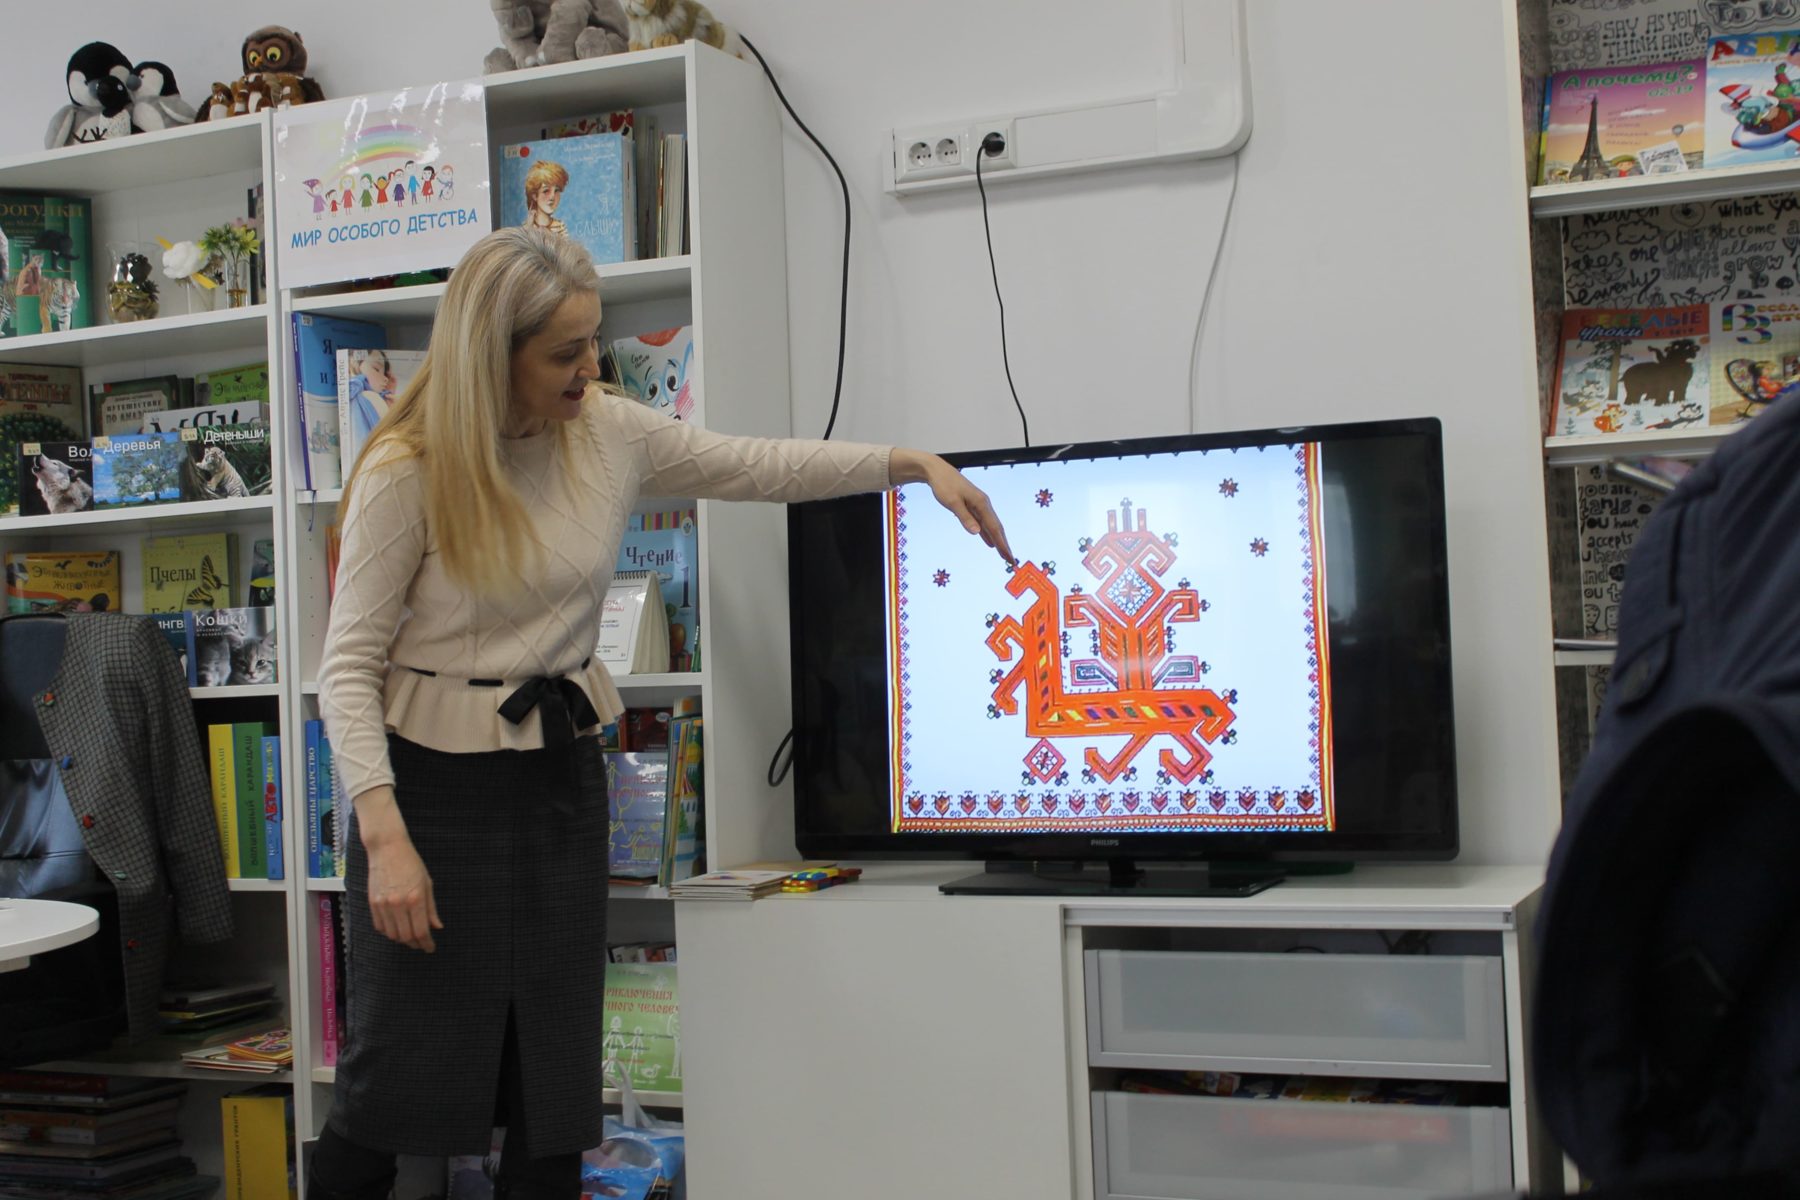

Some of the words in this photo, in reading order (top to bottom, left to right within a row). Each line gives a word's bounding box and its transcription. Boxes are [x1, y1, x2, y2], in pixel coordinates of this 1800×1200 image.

[1603, 17, 1638, 39] SAY
[1645, 13, 1666, 34] AS
[1667, 9, 1698, 31] YOU
[1602, 37, 1659, 58] THINK
[1661, 32, 1695, 51] AND
[1563, 75, 1580, 89] А
[1586, 64, 1696, 88] почему?
[1718, 200, 1764, 217] what
[291, 229, 321, 249] МИР
[328, 219, 401, 243] ОСОБОГО
[407, 208, 477, 235] ДЕТСТВА
[204, 429, 264, 444] Детеныши
[104, 440, 161, 454] Деревья
[1586, 531, 1634, 549] accepts
[625, 546, 683, 568] Чтение
[150, 566, 196, 583] Пчелы
[680, 566, 692, 608] 1
[195, 614, 248, 626] Кошки
[308, 747, 316, 795] ЦАРСТВО
[605, 987, 673, 1000] РИКЛЮЧЕНИЯ
